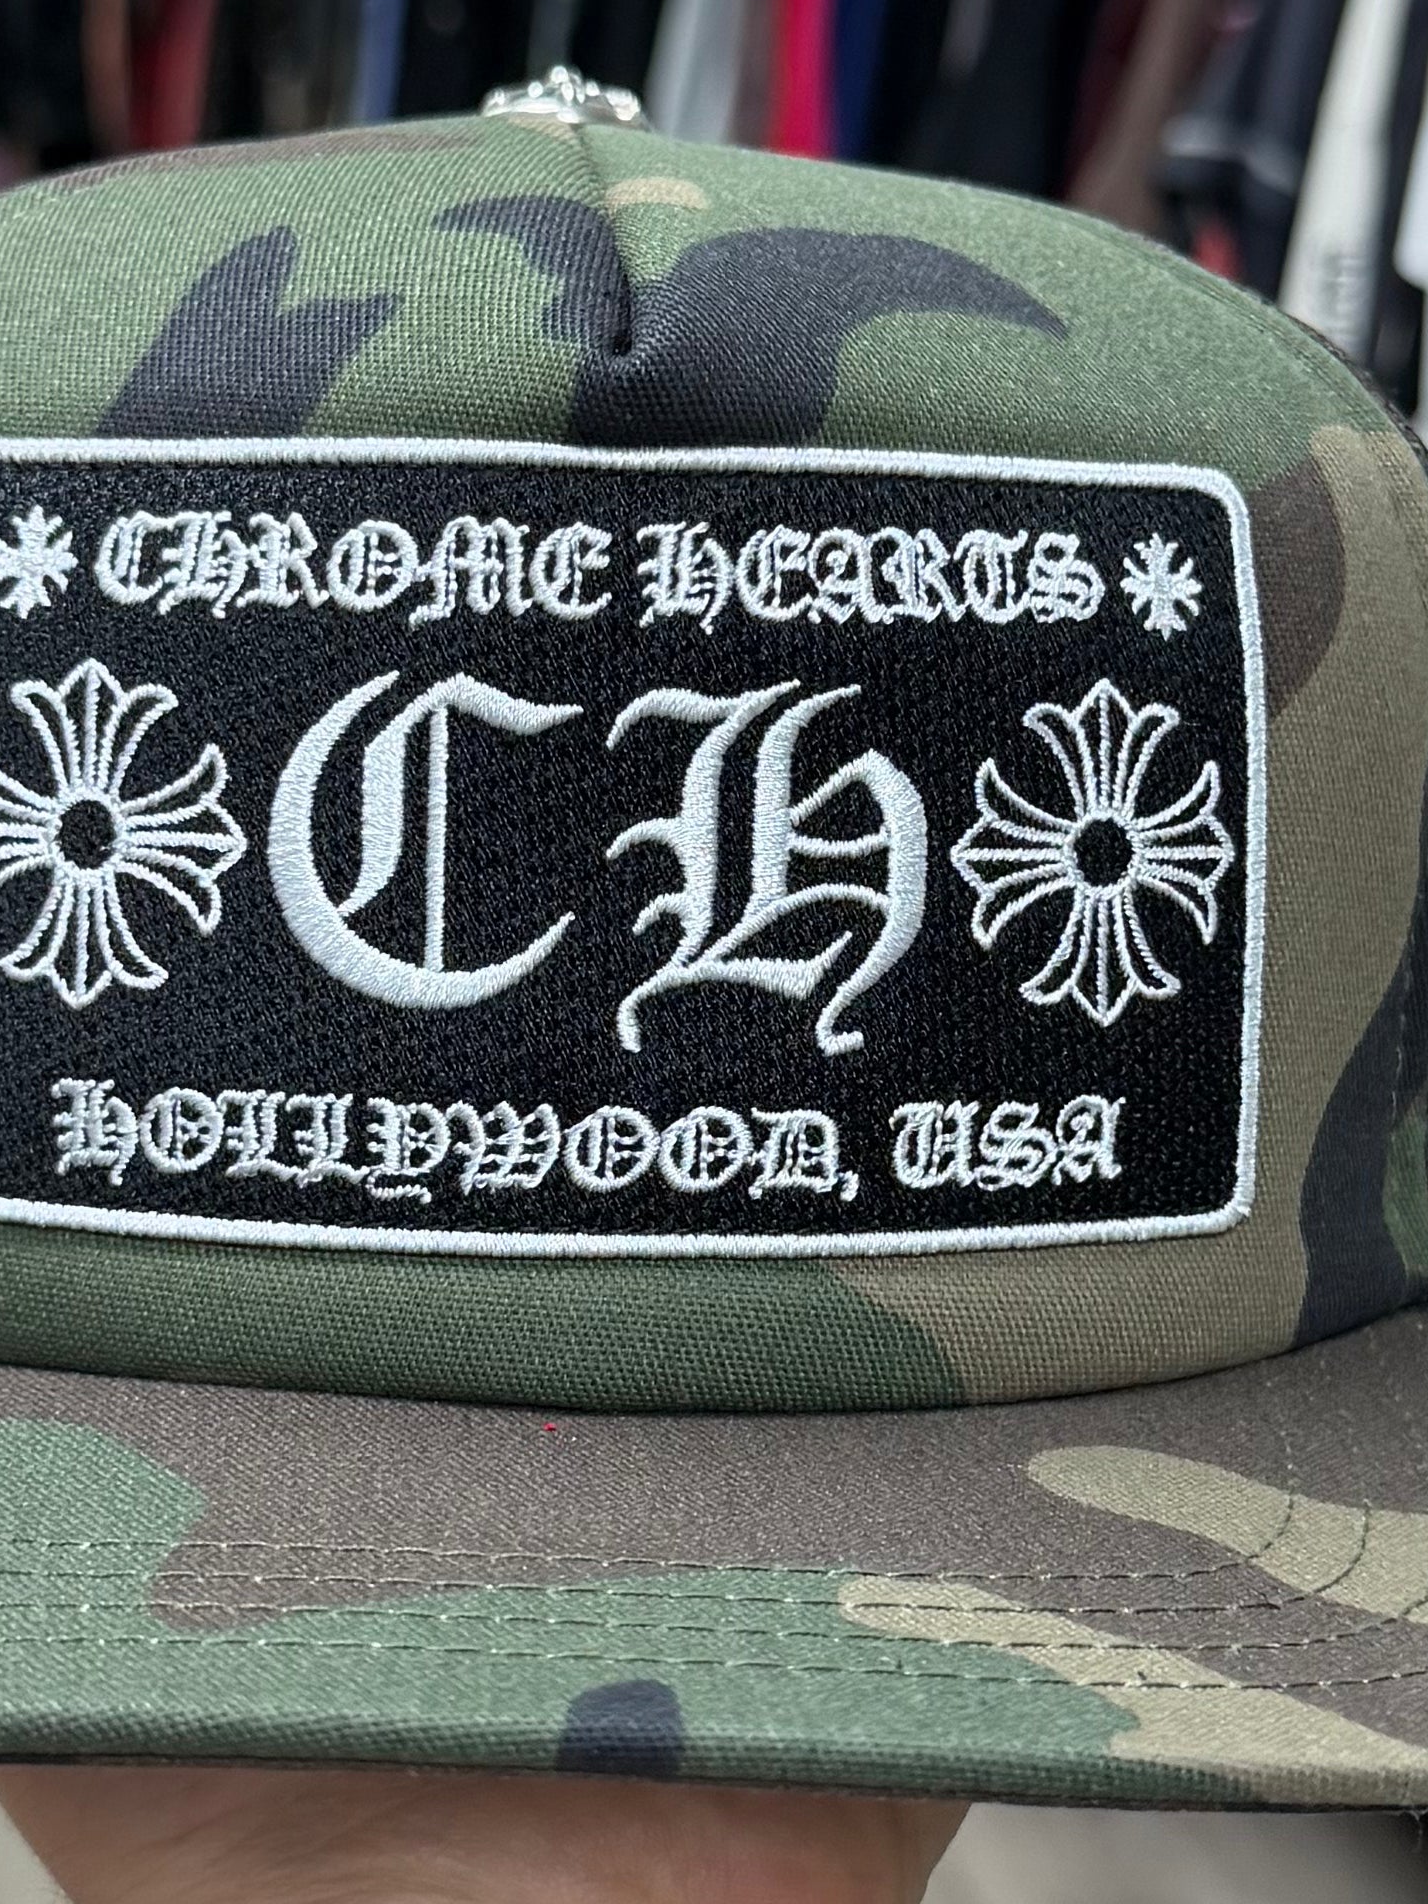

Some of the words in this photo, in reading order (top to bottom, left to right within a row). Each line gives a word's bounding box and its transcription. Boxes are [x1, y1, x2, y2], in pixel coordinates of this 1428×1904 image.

[95, 510, 612, 628] CHROME
[638, 521, 1106, 634] HEARTS
[51, 1078, 860, 1204] HOLLYWOOD,
[889, 1094, 1126, 1191] USA
